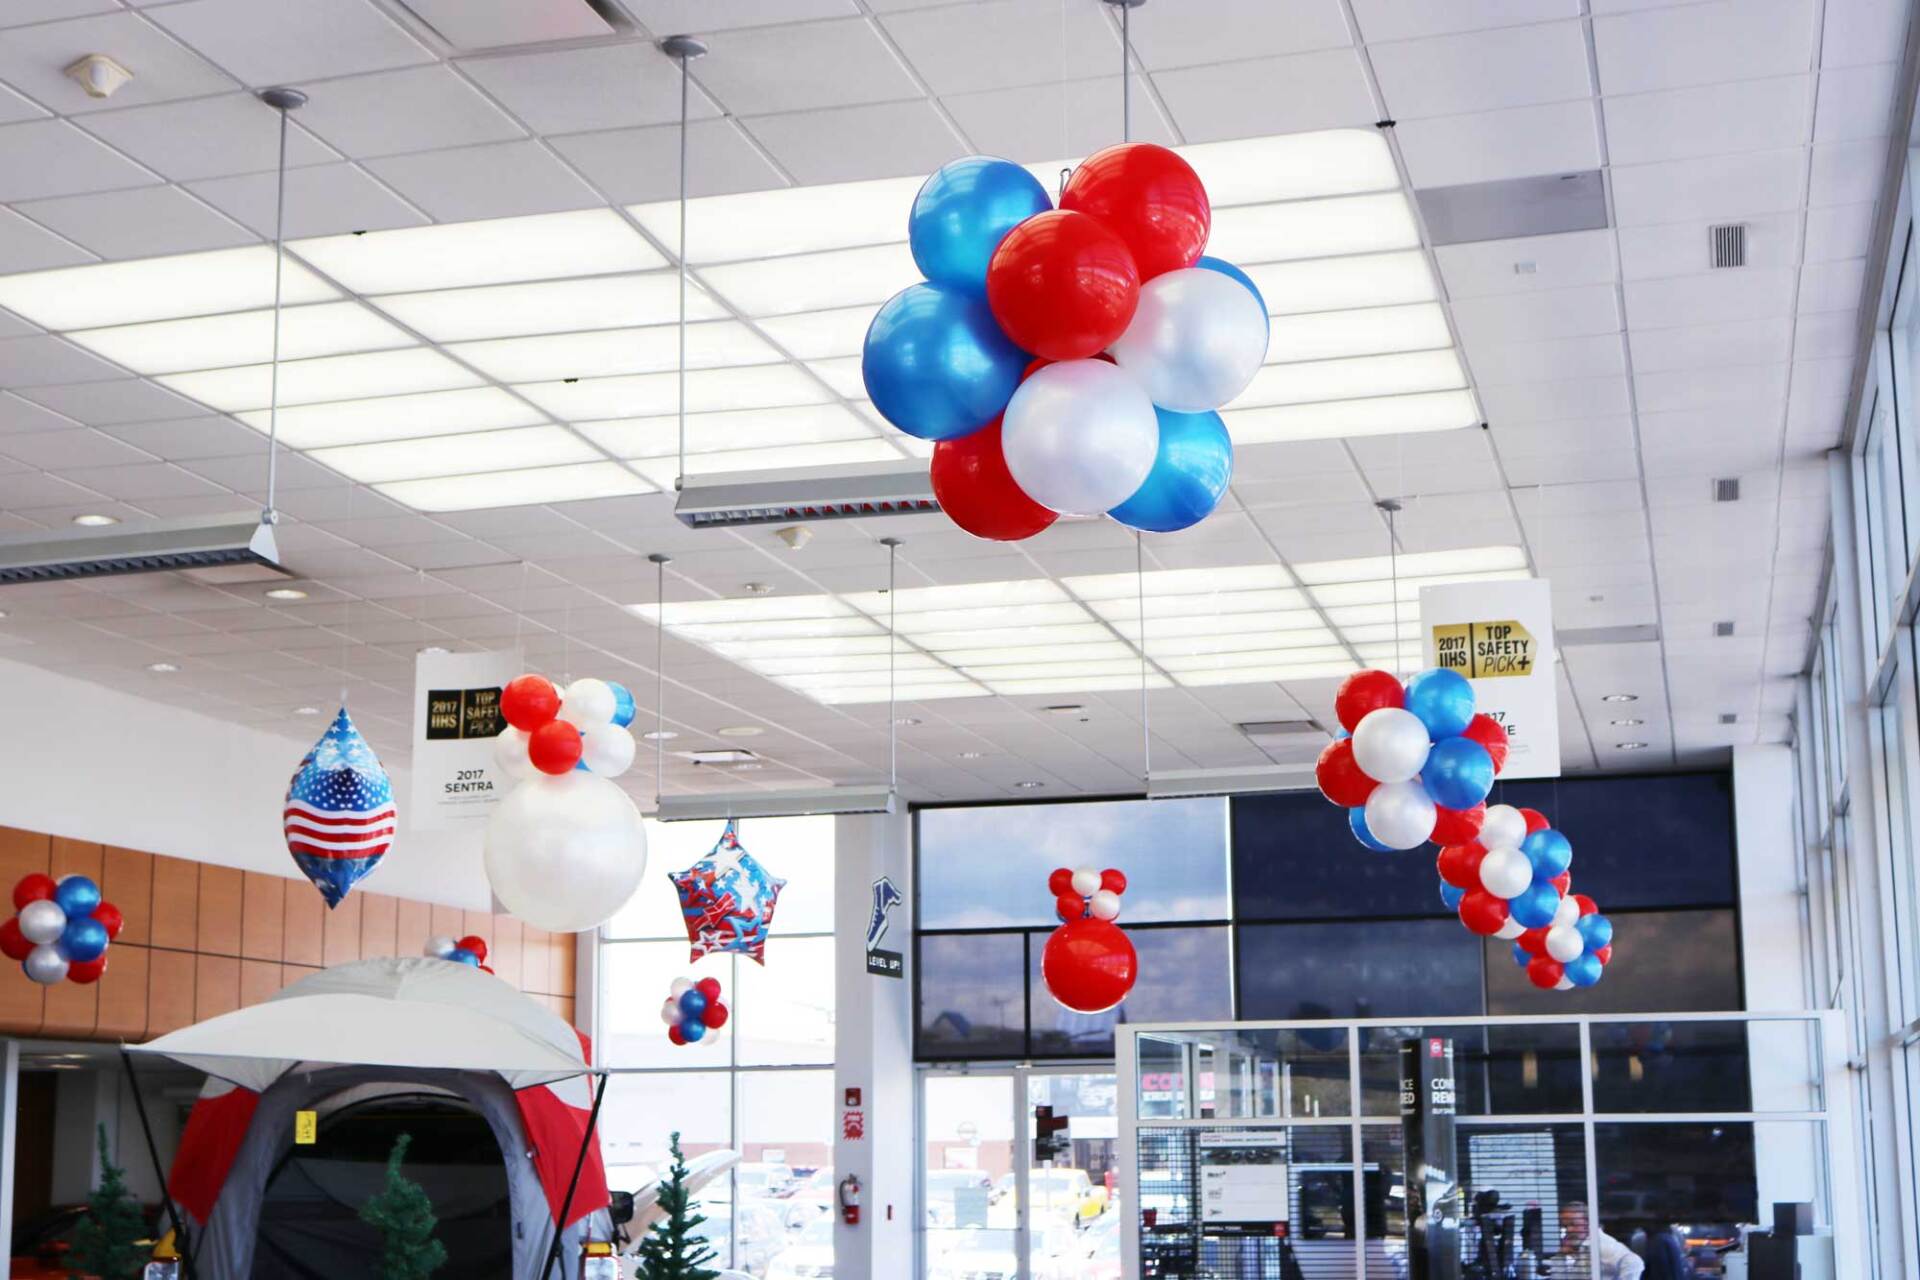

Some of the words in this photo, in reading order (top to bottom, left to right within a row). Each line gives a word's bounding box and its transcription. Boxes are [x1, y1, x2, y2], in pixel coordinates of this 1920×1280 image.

[1485, 625, 1511, 640] TOP
[1439, 636, 1465, 651] 2017
[1477, 640, 1529, 656] SAFETY
[1439, 651, 1467, 667] IIHS
[475, 691, 496, 704] TOP
[432, 701, 457, 713] 2017
[466, 705, 500, 720] SAFET
[431, 714, 457, 728] IIHS
[456, 769, 484, 780] 2017
[445, 781, 494, 793] SENTRA
